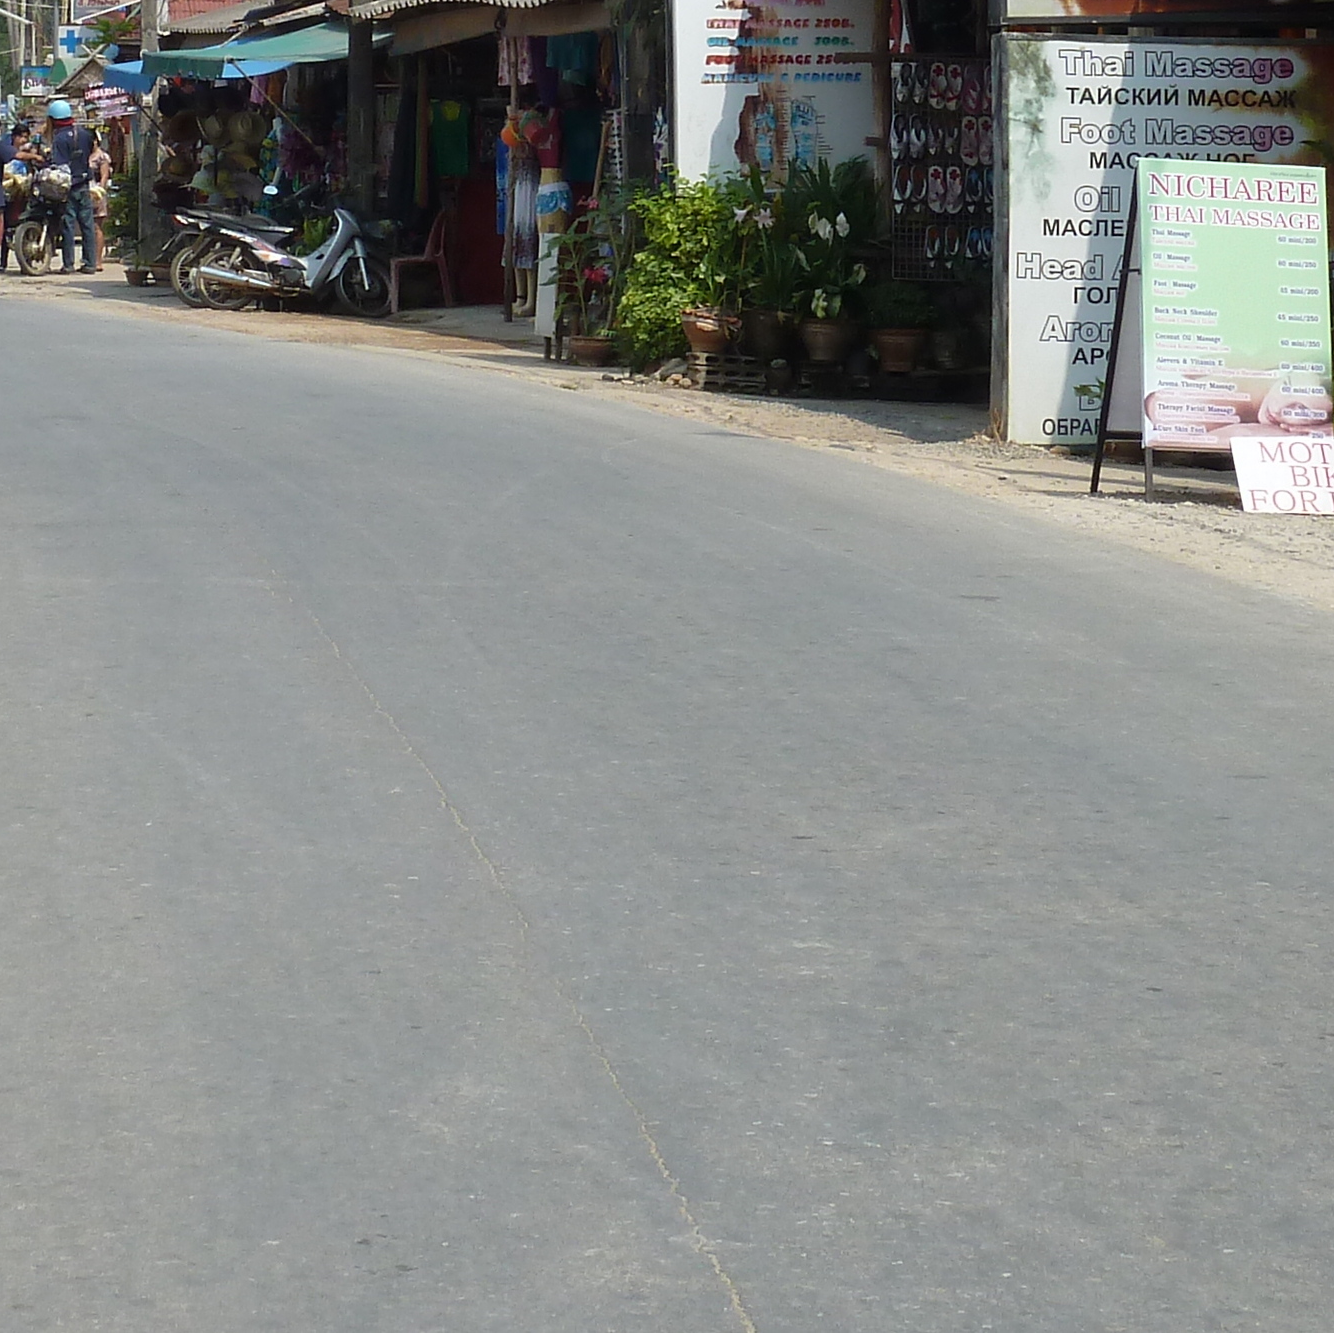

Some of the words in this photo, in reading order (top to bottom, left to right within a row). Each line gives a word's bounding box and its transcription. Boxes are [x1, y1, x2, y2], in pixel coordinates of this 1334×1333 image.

[747, 55, 812, 65] MASSAGE
[1058, 49, 1135, 78] Thai
[1144, 50, 1295, 85] Massage
[793, 73, 863, 83] PEDICURE
[1065, 84, 1180, 107] ТАЙСКИЙ
[1186, 88, 1298, 109] МАССАЖ
[1060, 116, 1136, 146] Foot
[1144, 118, 1295, 152] Massage
[1074, 185, 1121, 213] Oil
[1148, 172, 1318, 205] NICHAREE
[1149, 204, 1206, 224] THAI
[1211, 207, 1320, 230] MASSAGE
[1166, 229, 1191, 238] Massage
[1015, 252, 1104, 281] Head
[1249, 489, 1321, 512] FOR
